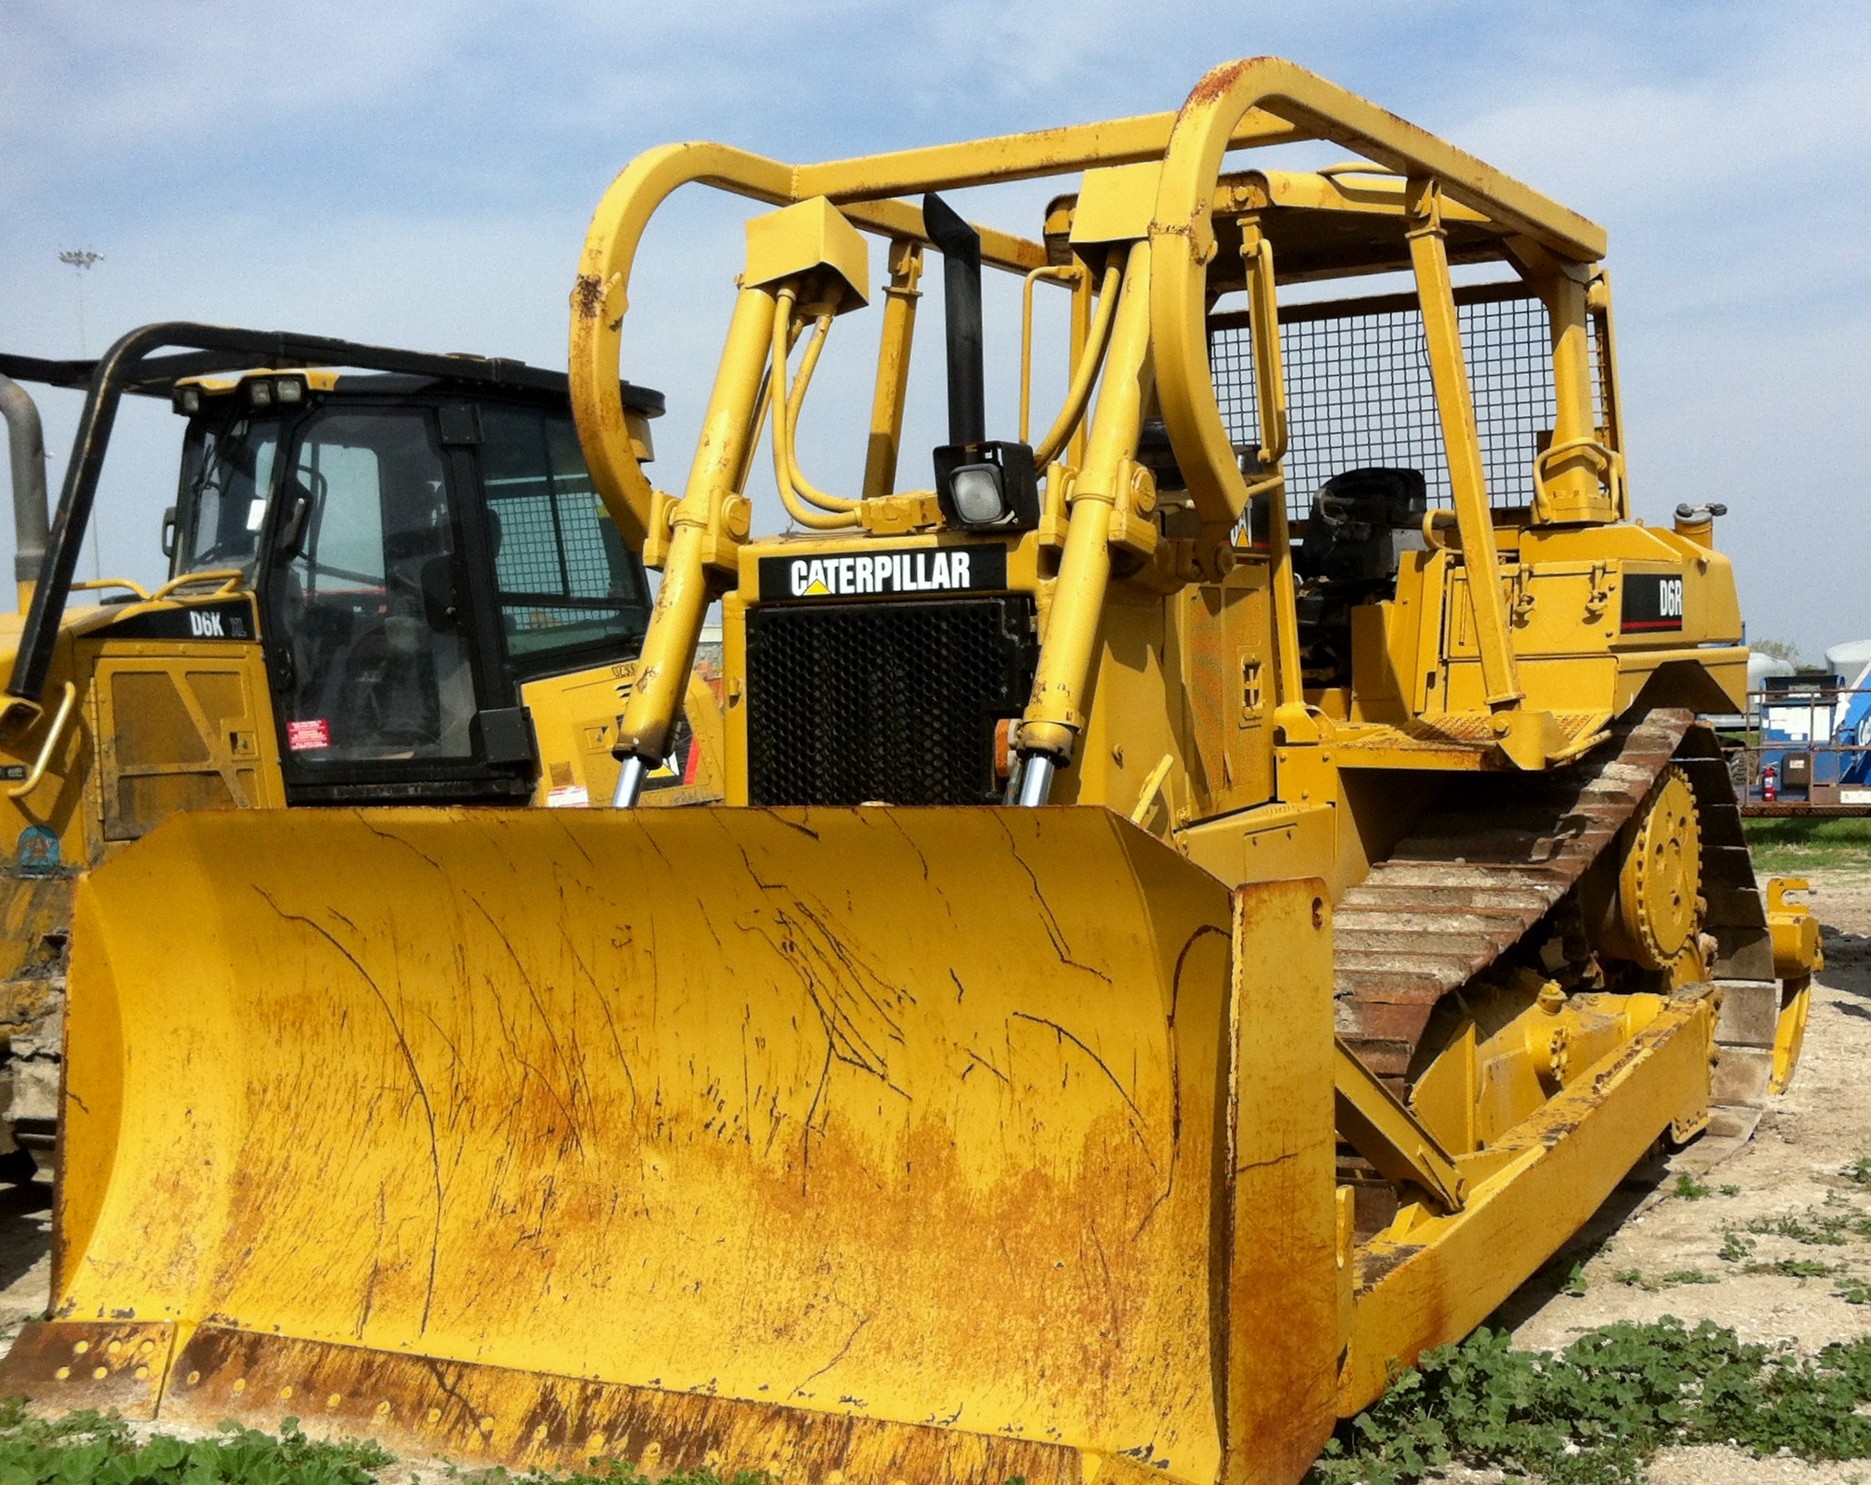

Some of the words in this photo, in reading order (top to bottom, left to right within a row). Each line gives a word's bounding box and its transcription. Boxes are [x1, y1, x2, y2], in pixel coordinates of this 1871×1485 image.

[791, 551, 971, 597] CATERPILLAR
[1659, 579, 1682, 616] D6R
[189, 610, 225, 637] D6K
